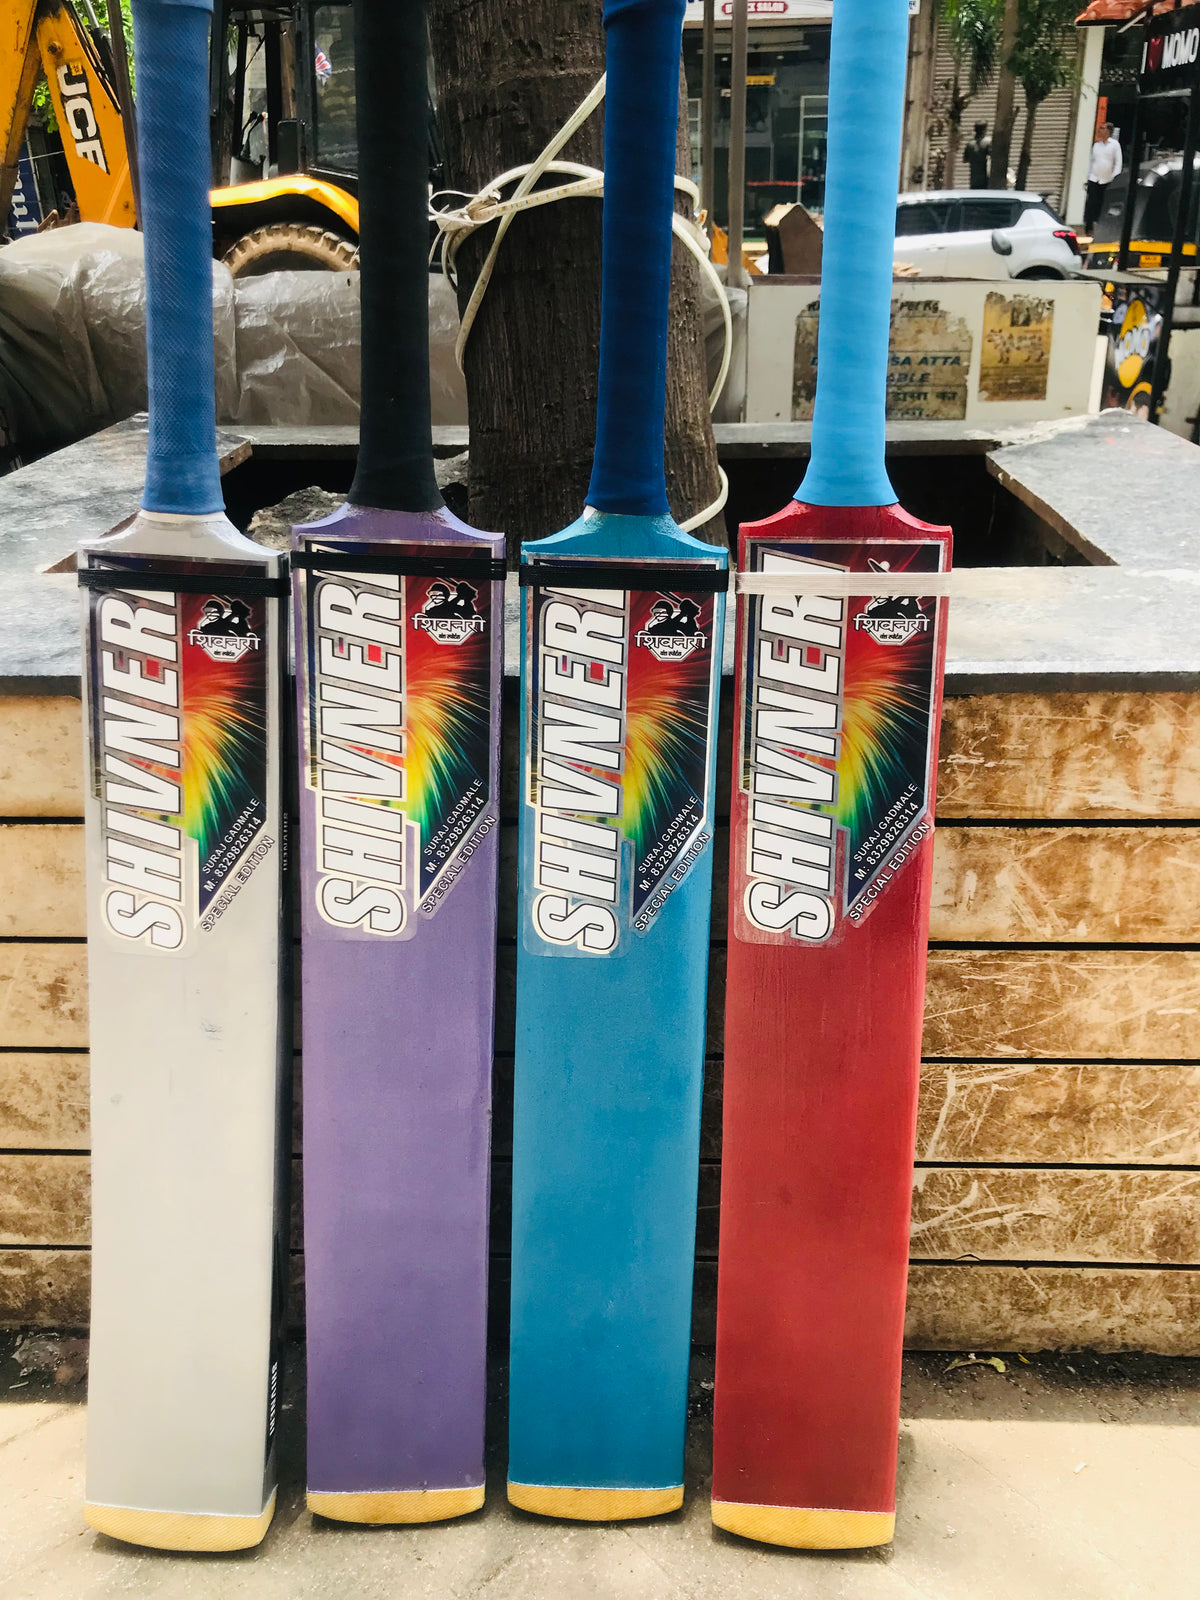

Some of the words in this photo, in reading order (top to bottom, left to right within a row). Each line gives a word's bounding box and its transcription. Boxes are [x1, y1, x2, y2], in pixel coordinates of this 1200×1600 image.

[1161, 27, 1200, 69] MOMO
[918, 356, 961, 366] ATTA
[187, 629, 261, 650] शिवनेरी
[411, 612, 486, 633] शिवनेरी
[634, 629, 708, 649] शिवनेरी
[853, 612, 930, 632] शिवनेरी
[202, 843, 227, 874] SURAJ
[224, 798, 260, 843] GADMALE
[203, 878, 219, 892] M:
[214, 816, 262, 878] 8329826314
[423, 824, 450, 856] SURAJ
[446, 778, 483, 824] GADMALE
[425, 859, 440, 874] M:
[436, 796, 485, 858] 8329826314
[638, 841, 664, 874] SURAJ
[661, 795, 698, 842] GADMALE
[639, 876, 654, 892] M:
[650, 814, 699, 876] 8329826314
[853, 830, 881, 862] SURAJ
[878, 783, 918, 829] GADMALE
[854, 865, 870, 881] M:
[866, 802, 919, 865] 8329826314
[201, 884, 241, 932] SPECIAL
[235, 835, 275, 884] EDITION
[422, 864, 462, 913] SPECIAL
[458, 815, 496, 863] EDITION
[635, 883, 676, 931] SPECIAL
[671, 832, 711, 881] EDITION
[849, 872, 893, 921] SPECIAL
[888, 821, 931, 871] EDITION
